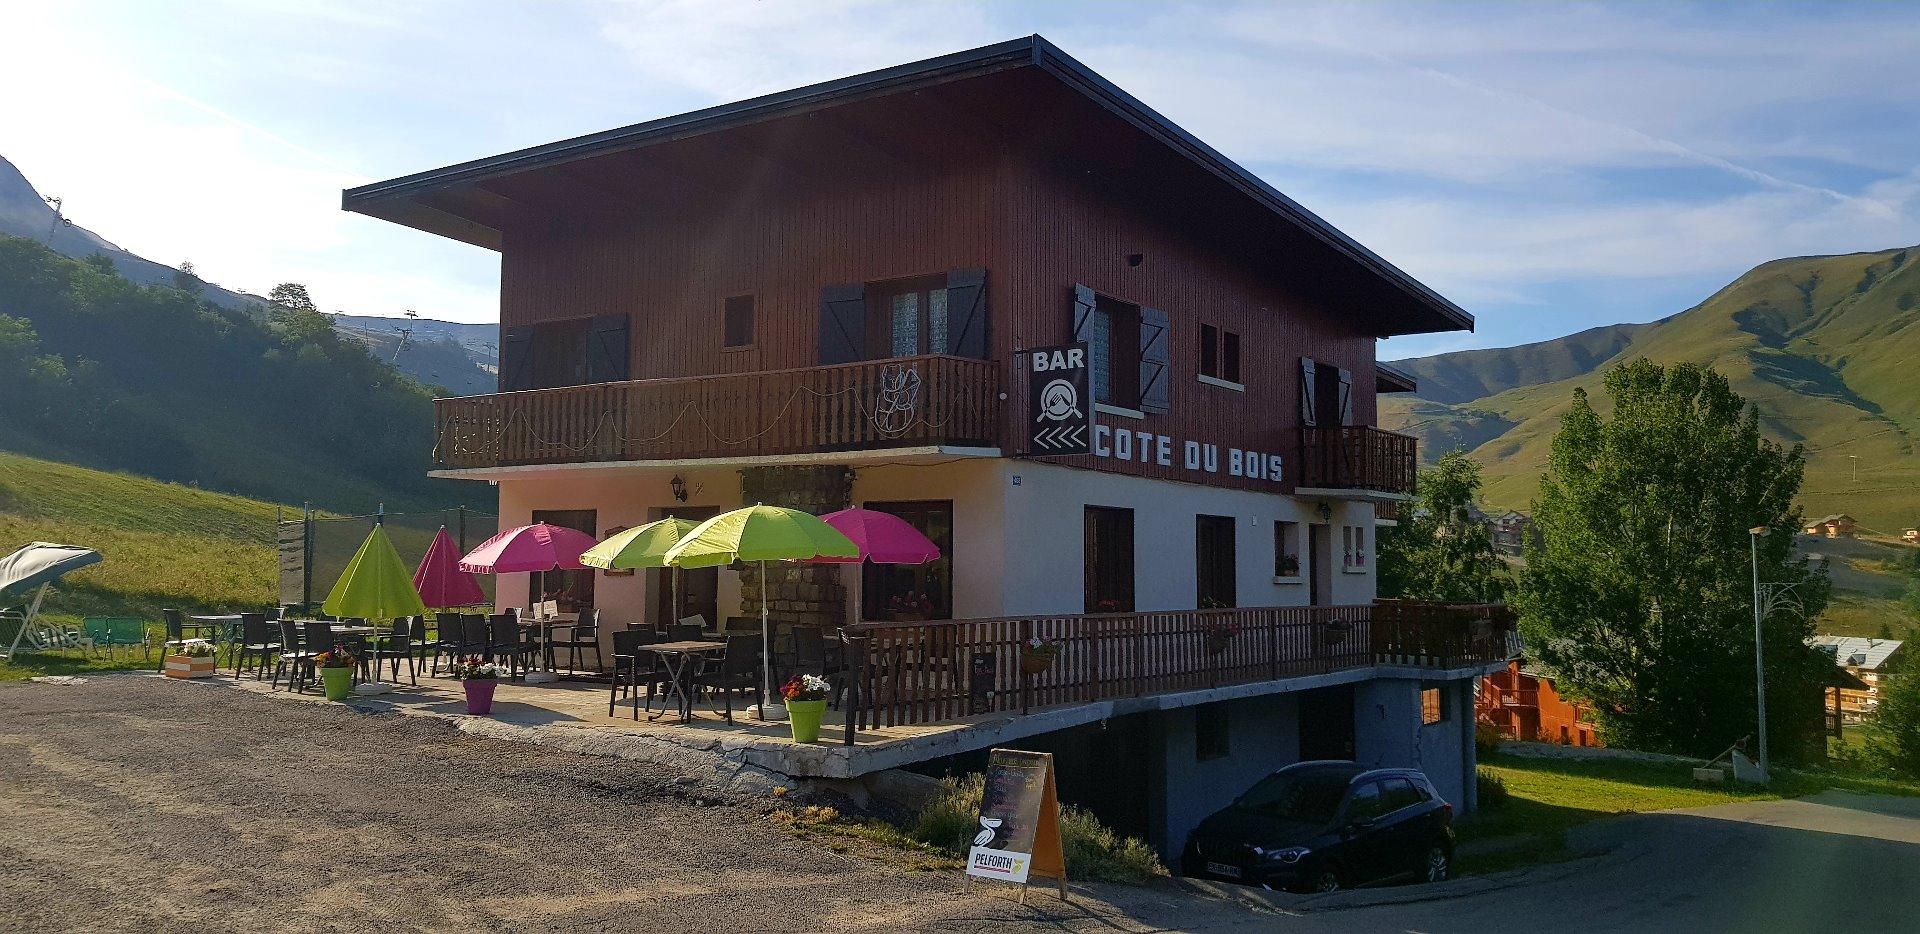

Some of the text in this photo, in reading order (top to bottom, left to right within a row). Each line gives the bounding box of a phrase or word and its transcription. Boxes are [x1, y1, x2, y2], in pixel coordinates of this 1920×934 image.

[1032, 349, 1085, 372] BAR
[1095, 424, 1283, 482] COTE DU BOIS
[974, 852, 1013, 869] PELFORTH
